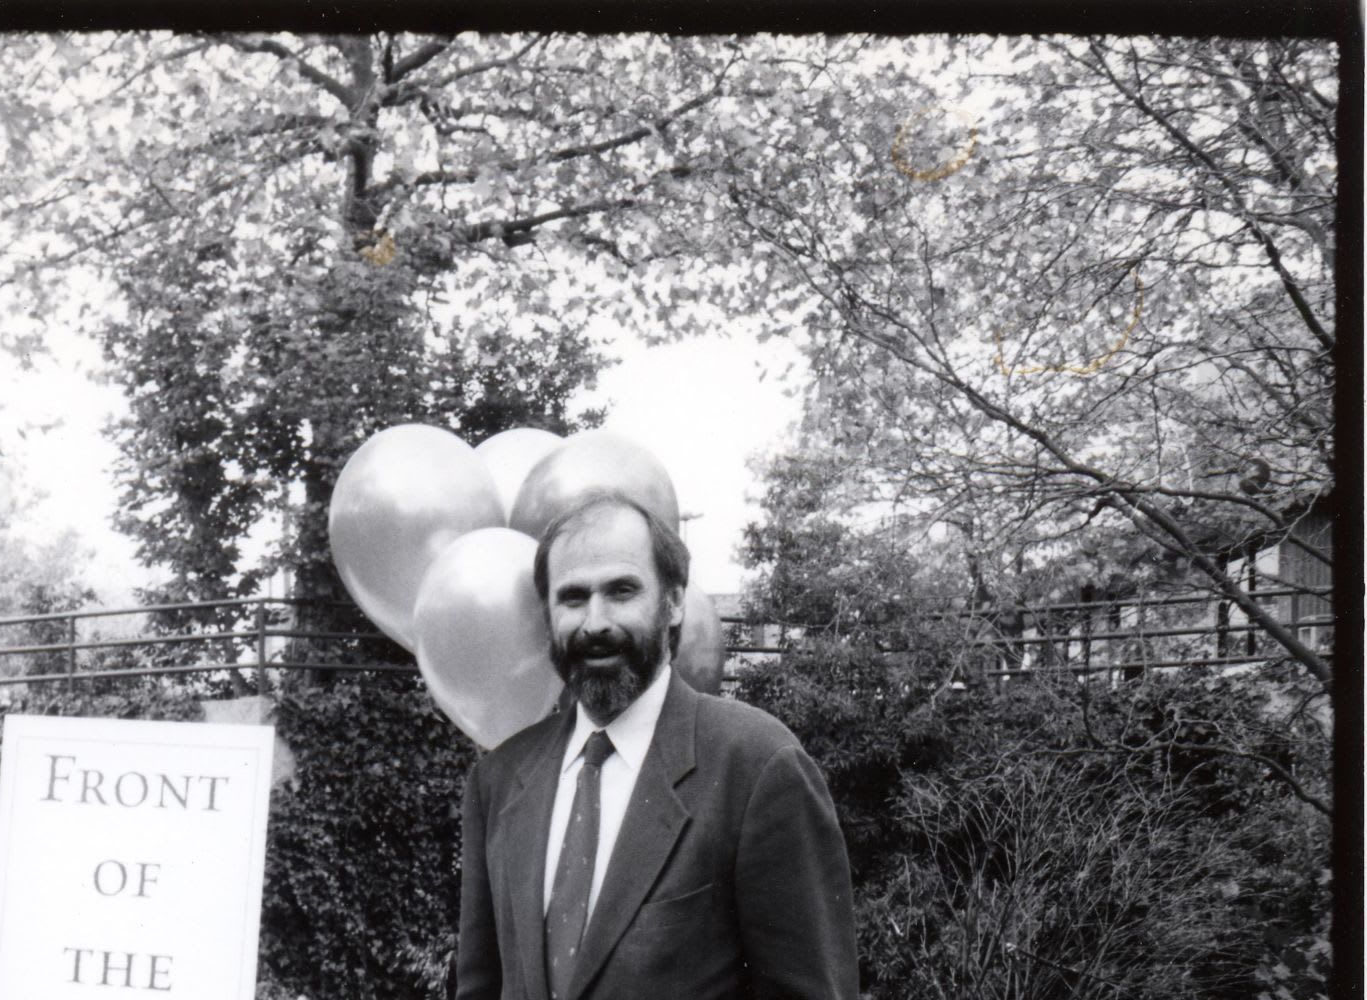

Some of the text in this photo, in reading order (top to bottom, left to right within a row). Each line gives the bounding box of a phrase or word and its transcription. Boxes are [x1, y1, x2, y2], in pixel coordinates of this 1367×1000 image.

[40, 754, 230, 812] FRONT
[93, 860, 161, 897] OF
[64, 946, 173, 992] THE
